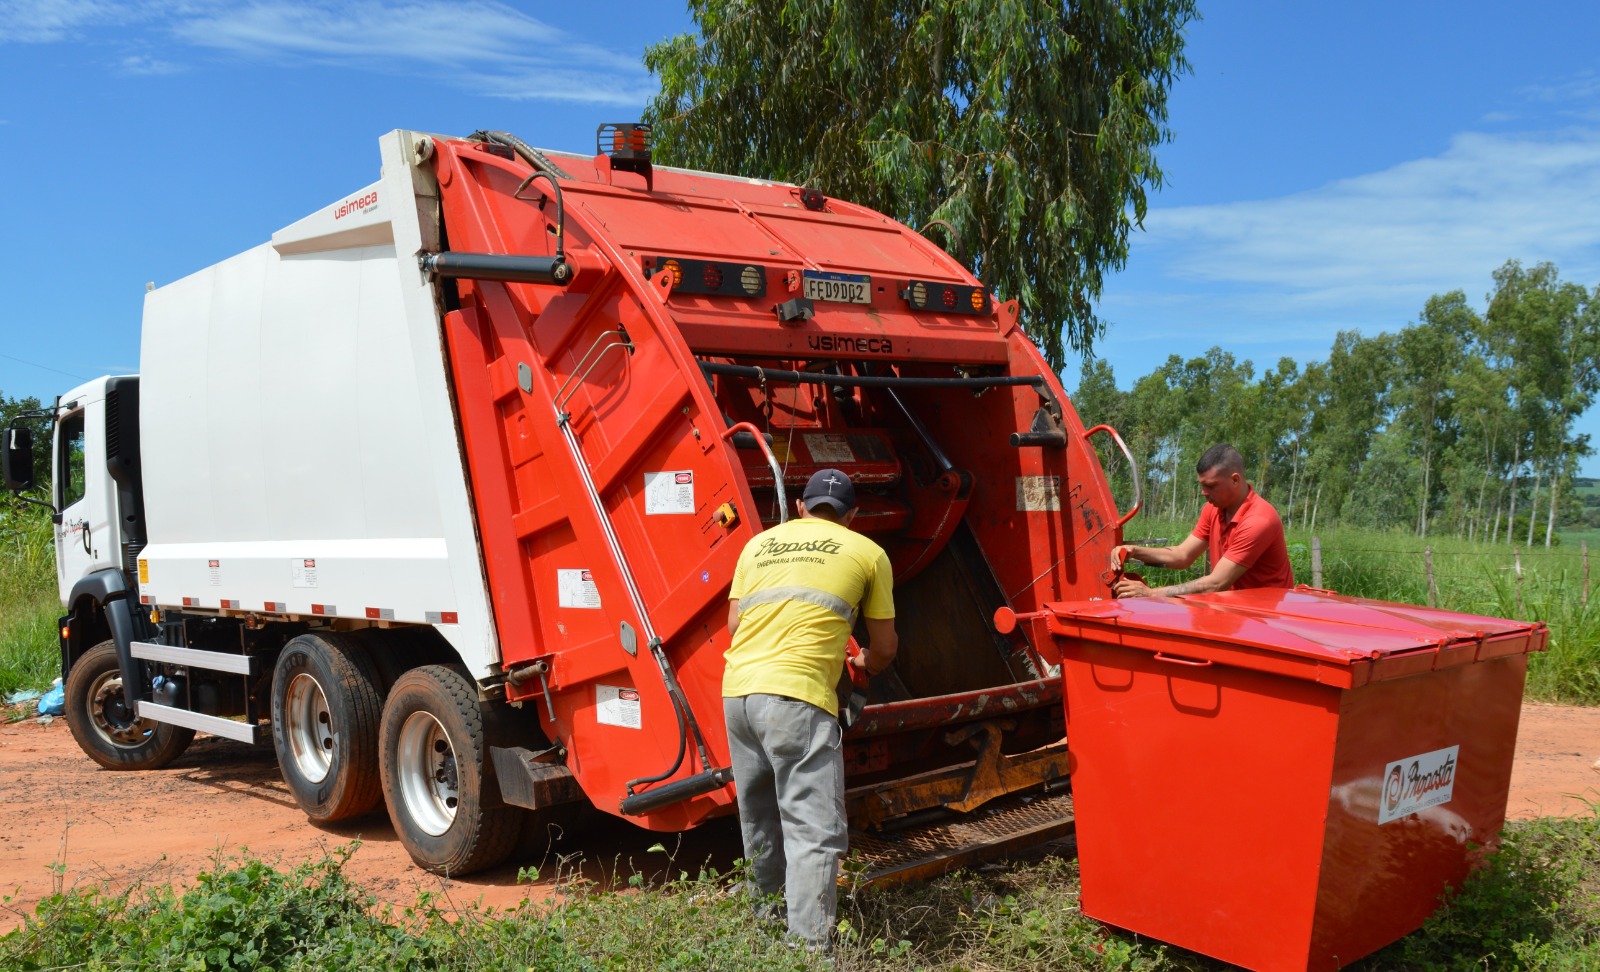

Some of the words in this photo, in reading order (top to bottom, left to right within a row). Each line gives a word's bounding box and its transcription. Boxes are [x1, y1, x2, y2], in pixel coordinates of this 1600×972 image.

[334, 191, 378, 220] usimeca
[807, 333, 893, 354] usimeca
[754, 537, 844, 557] Proposta
[756, 556, 790, 569] ENGENHARIA
[791, 556, 826, 566] AMBIENTAL
[1403, 753, 1455, 803] Proposta
